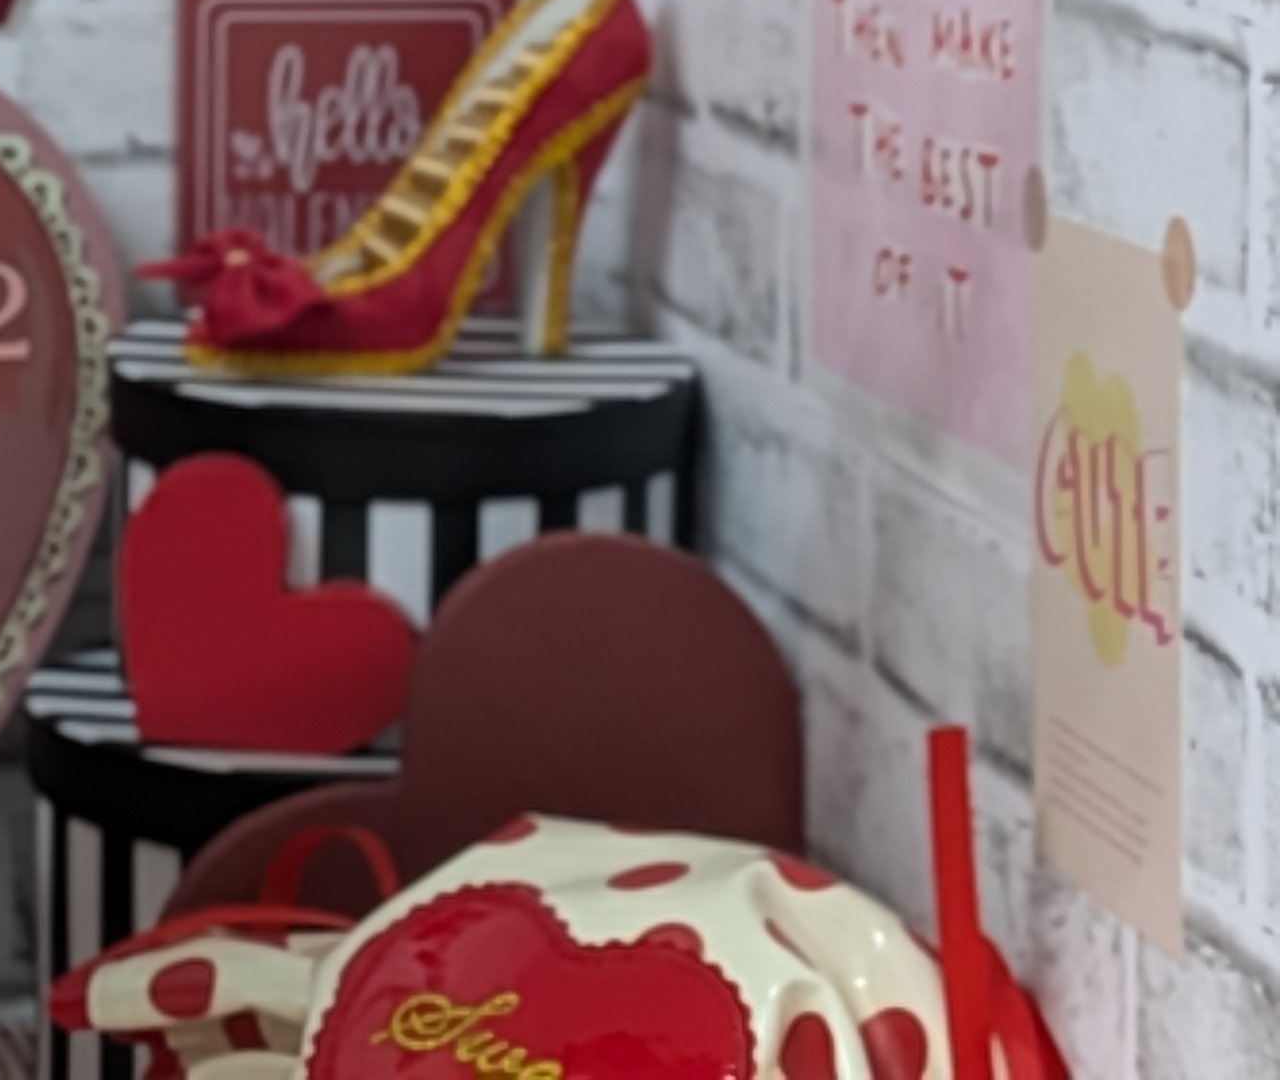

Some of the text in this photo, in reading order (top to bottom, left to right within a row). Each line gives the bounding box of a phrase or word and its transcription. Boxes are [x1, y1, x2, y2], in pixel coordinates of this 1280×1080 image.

[930, 8, 1014, 80] MAKE
[266, 44, 422, 193] hello
[848, 102, 1000, 228] THE BEST
[874, 248, 970, 345] OF IT
